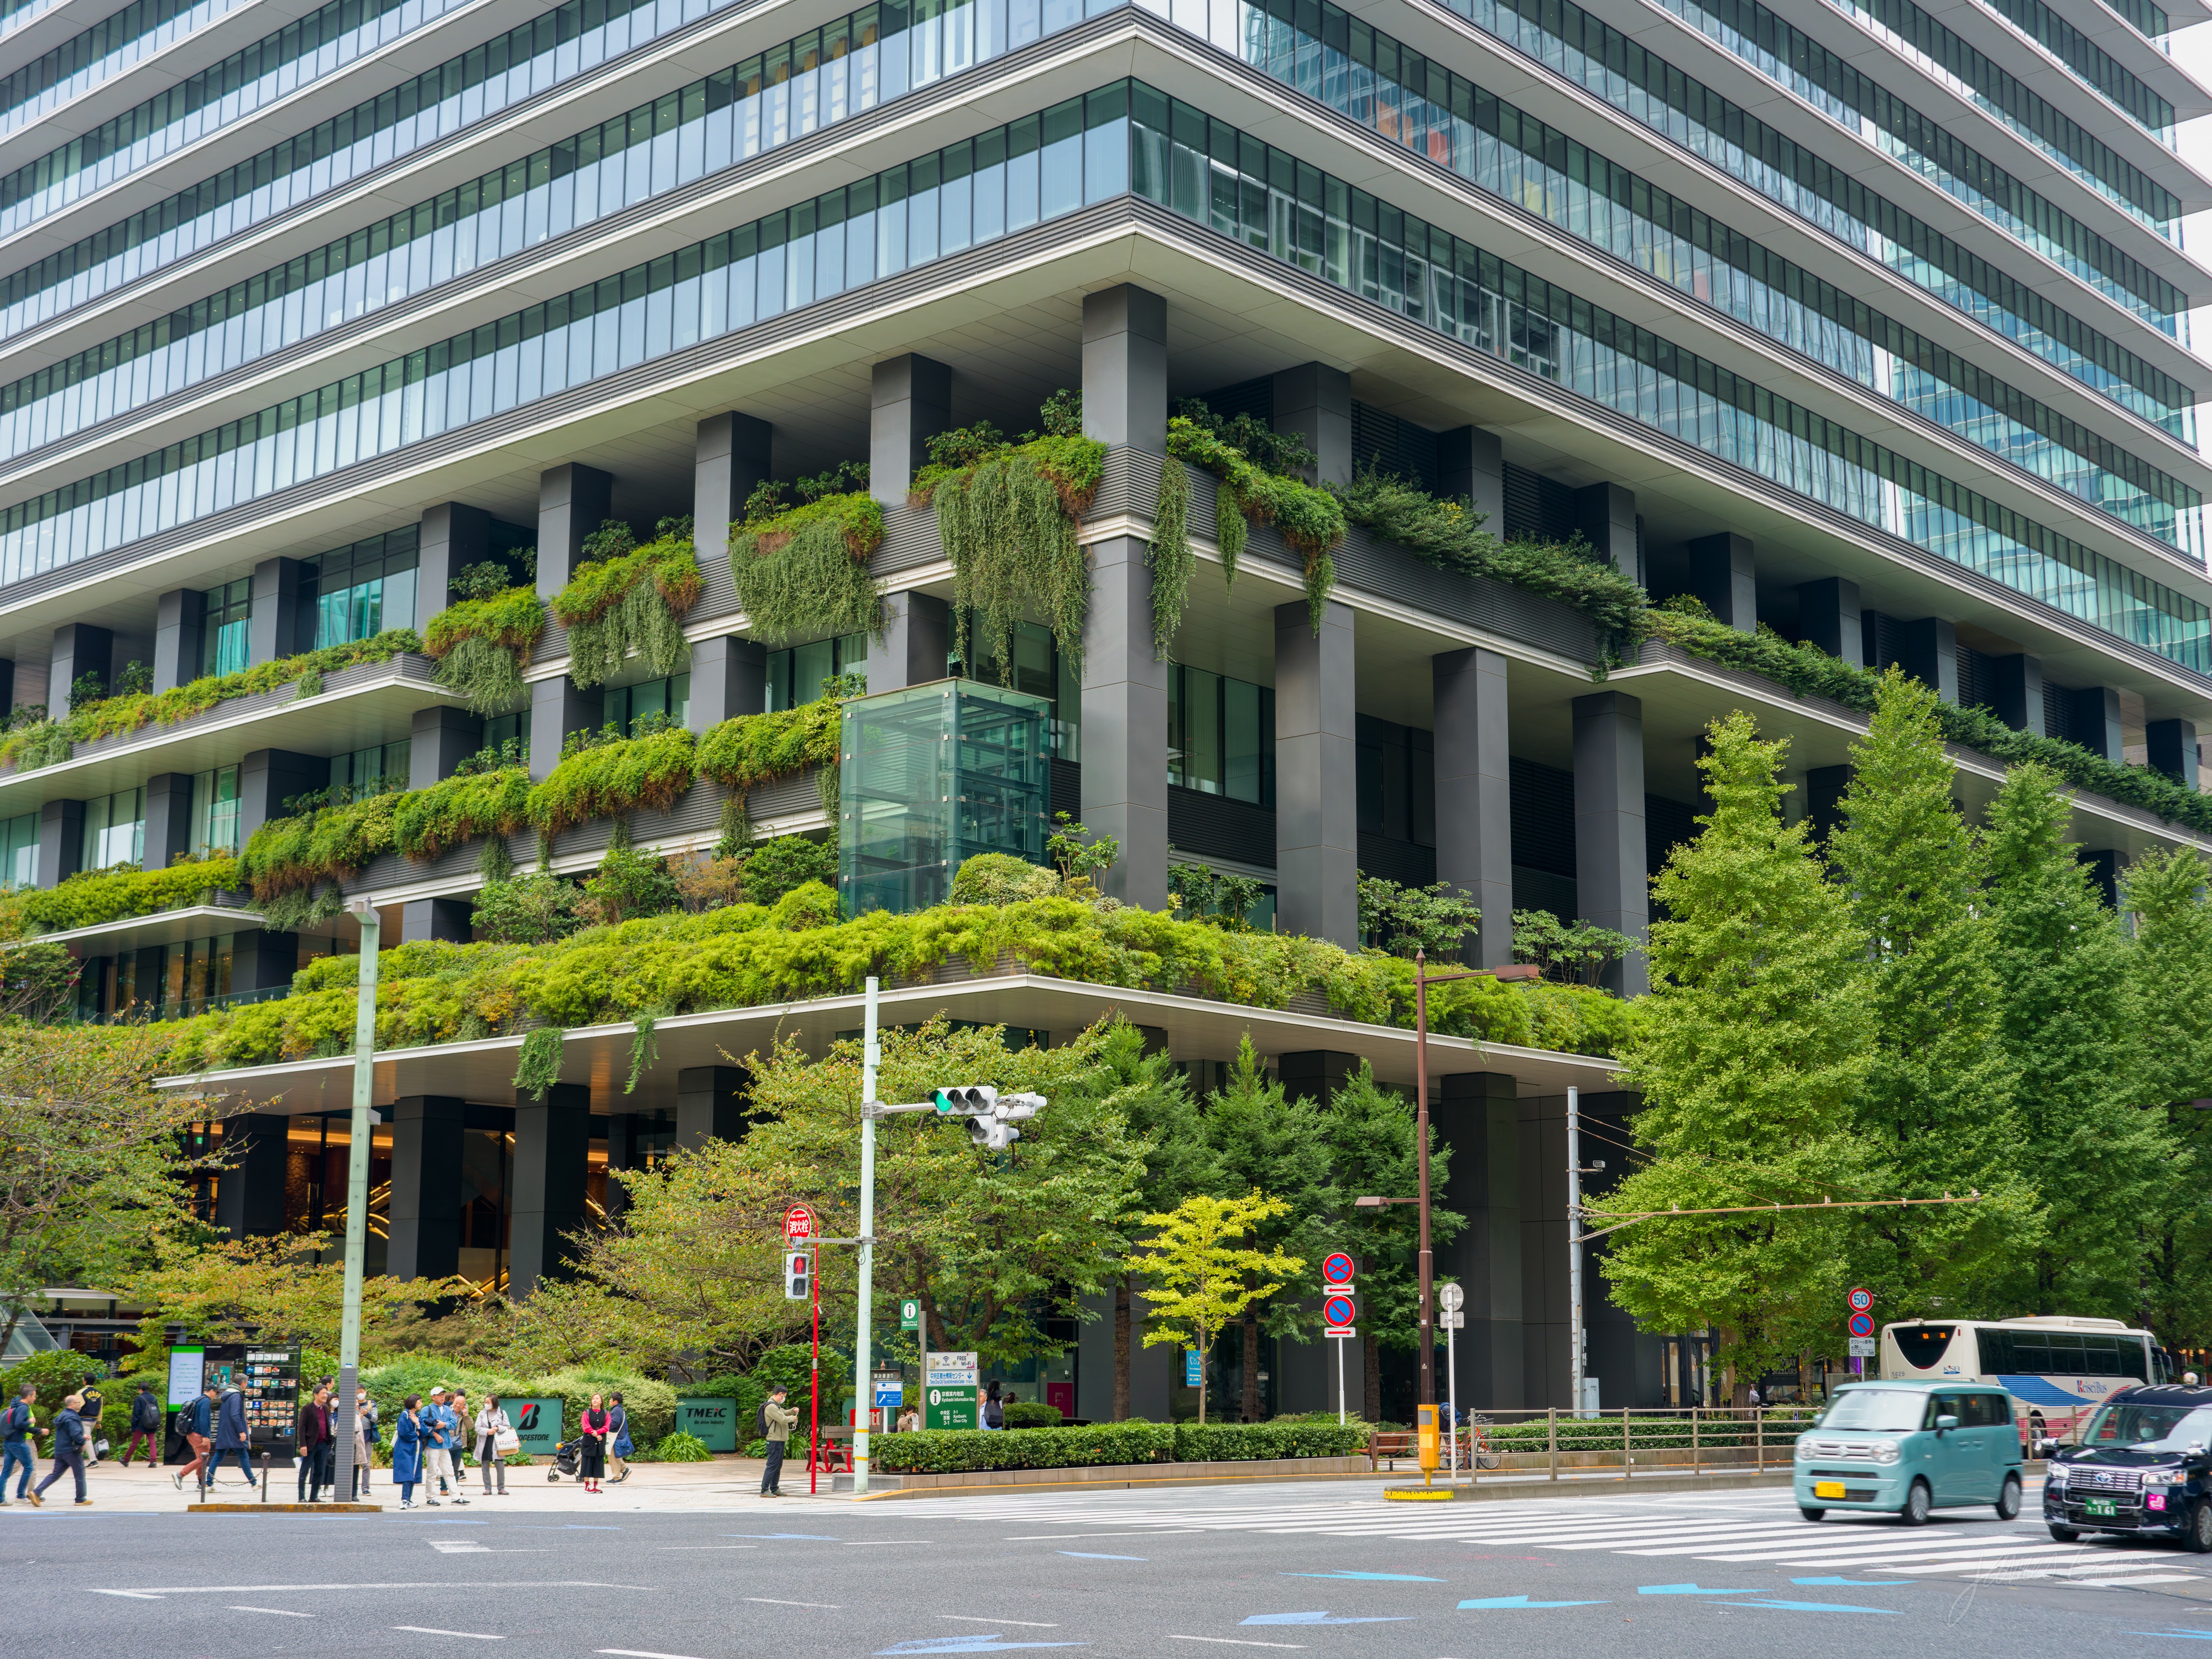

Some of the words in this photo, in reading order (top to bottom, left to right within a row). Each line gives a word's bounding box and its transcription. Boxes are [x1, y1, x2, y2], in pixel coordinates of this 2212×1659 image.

[789, 1219, 809, 1234] 消火栓
[1854, 1294, 1867, 1305] 50
[86, 1390, 102, 1399] STAFF
